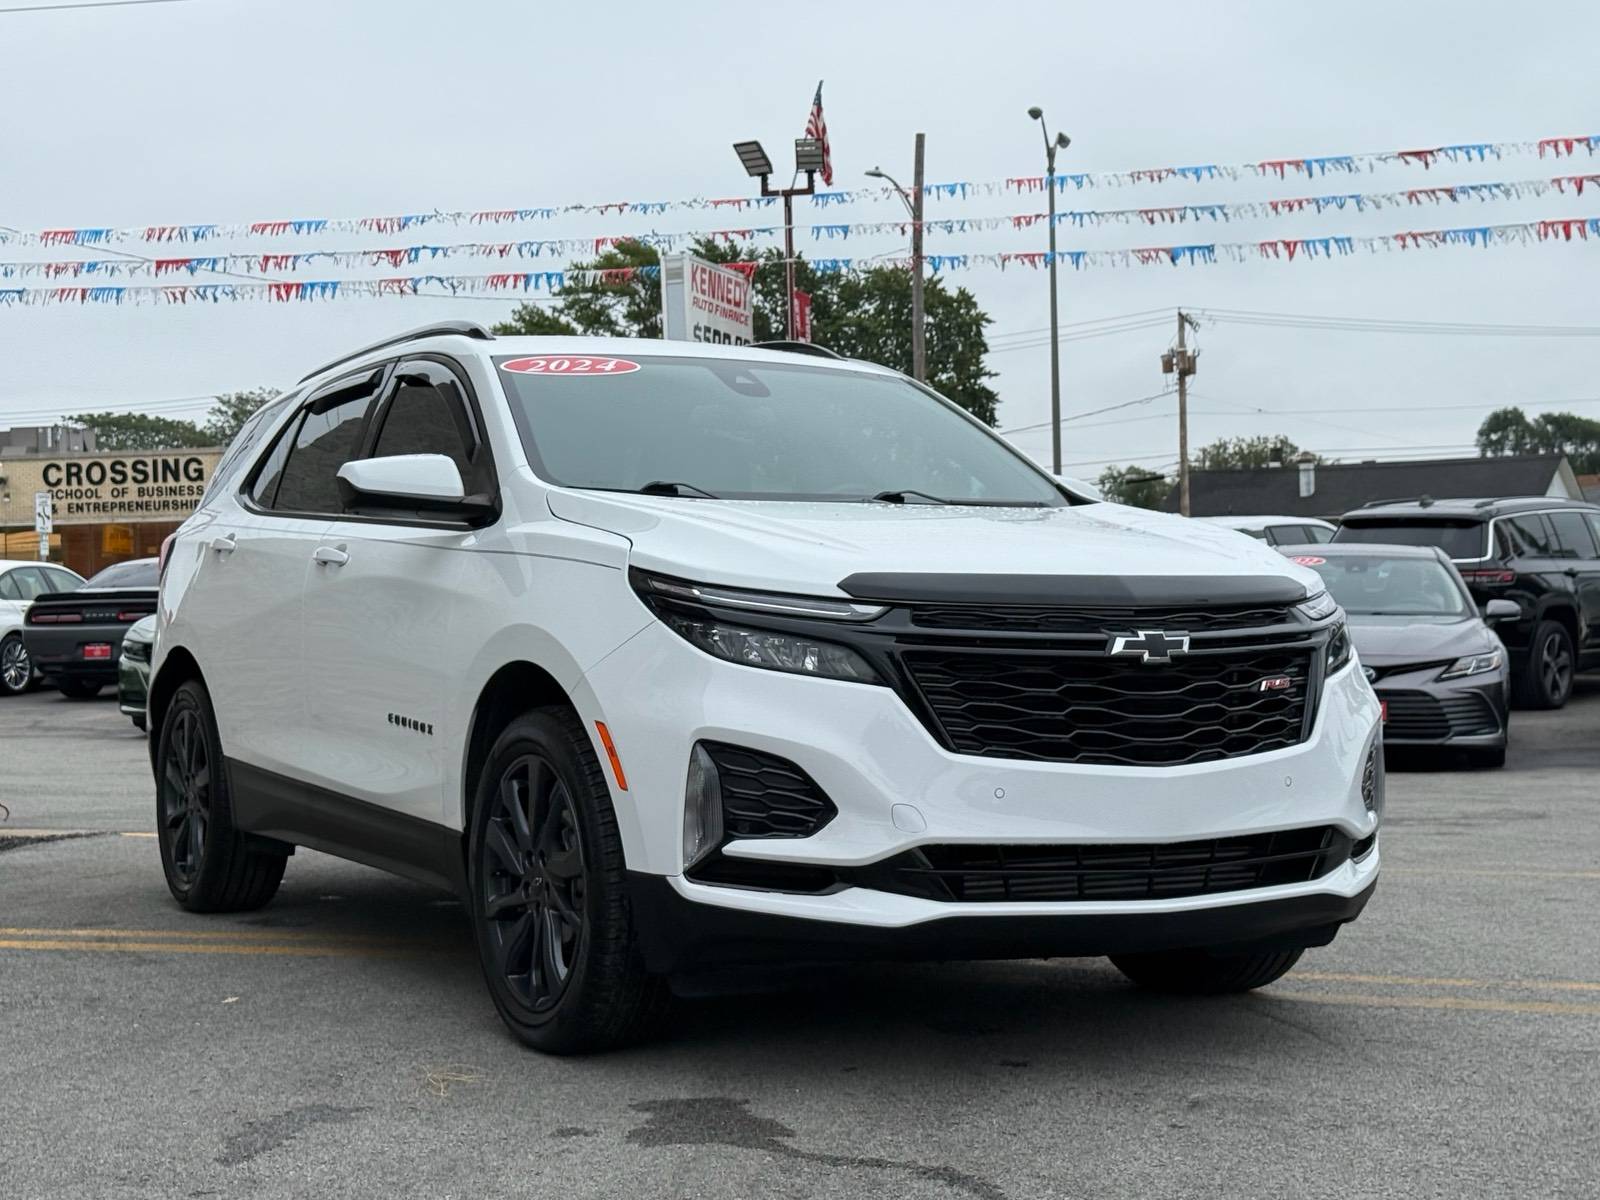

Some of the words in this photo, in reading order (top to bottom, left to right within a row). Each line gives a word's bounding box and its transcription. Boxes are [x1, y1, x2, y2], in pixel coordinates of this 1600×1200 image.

[691, 263, 750, 311] KENNEDY
[692, 296, 714, 314] AUTO
[714, 304, 749, 326] FINANCE
[525, 359, 617, 372] 2024
[42, 457, 204, 488] CROSSING
[111, 487, 129, 499] OF
[137, 485, 204, 498] BUSINESS
